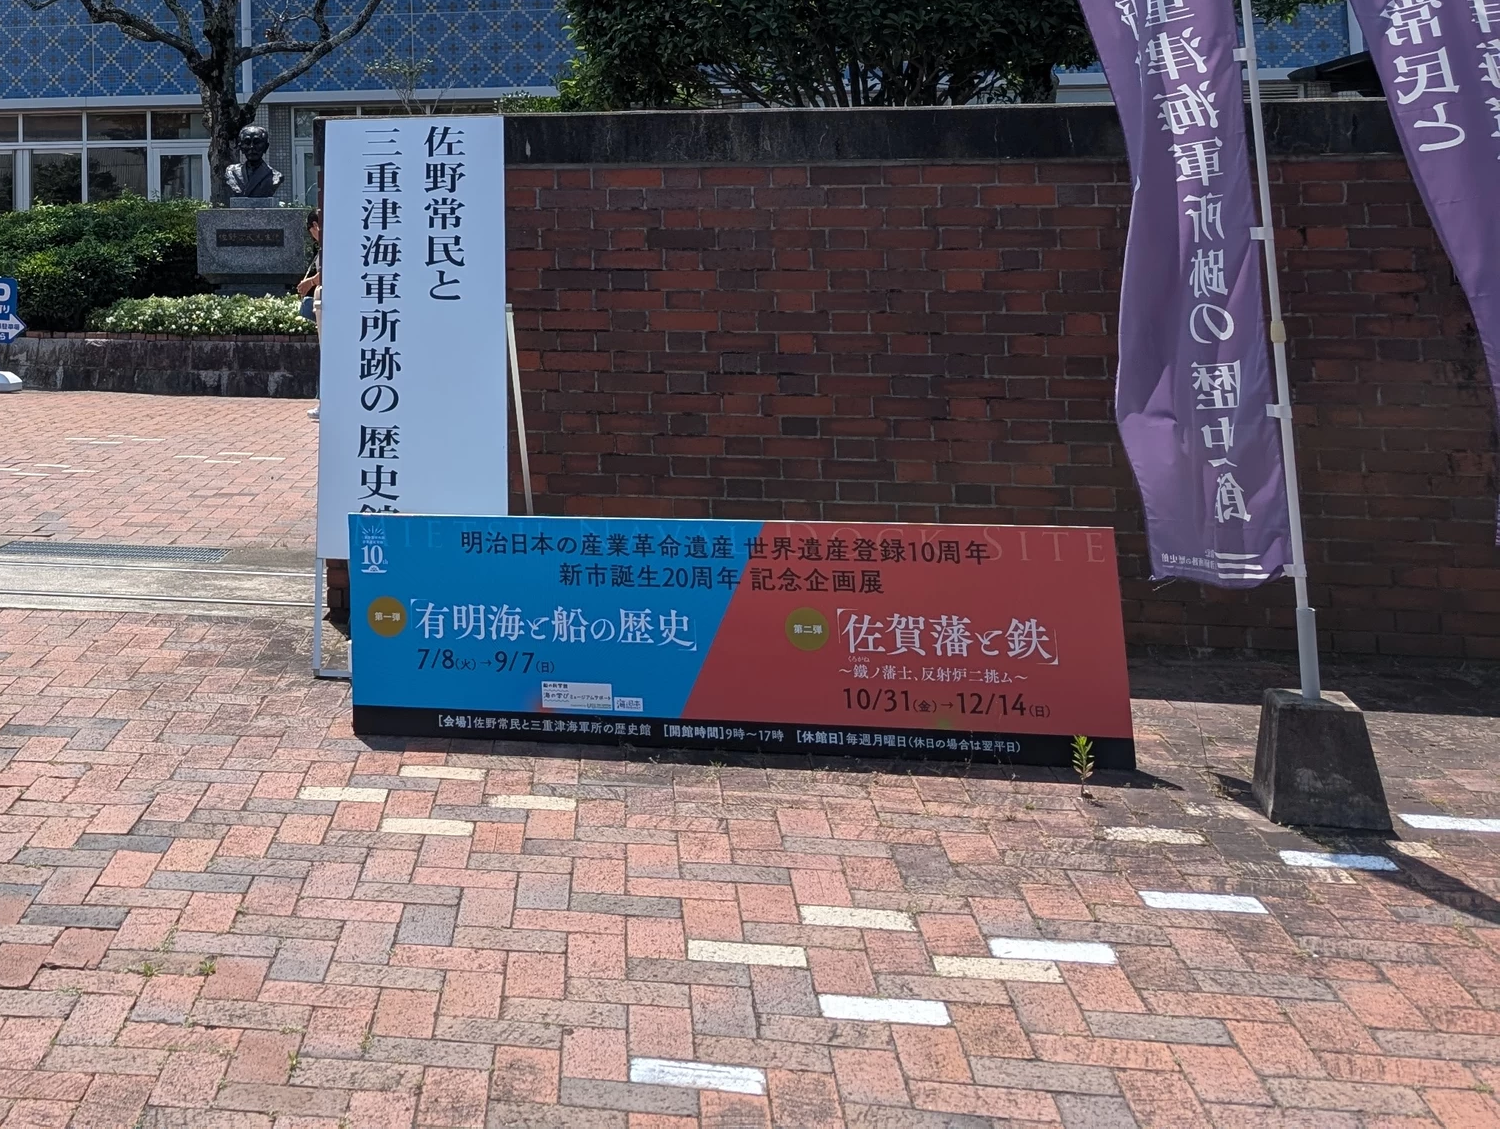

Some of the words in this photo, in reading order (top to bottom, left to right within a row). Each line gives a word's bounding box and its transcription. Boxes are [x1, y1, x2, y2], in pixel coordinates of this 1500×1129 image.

[424, 125, 466, 301] 佐野常民と
[357, 128, 401, 513] 三重津海軍所跡の歴史
[461, 531, 735, 559] 明治日本の産業革命遺産
[744, 536, 991, 565] 世界遺産登録10周年
[559, 562, 741, 590] 新市誕生20周年
[750, 567, 885, 594] 記念企画展
[374, 610, 401, 622] 第一弾
[793, 623, 823, 635] 第二弾
